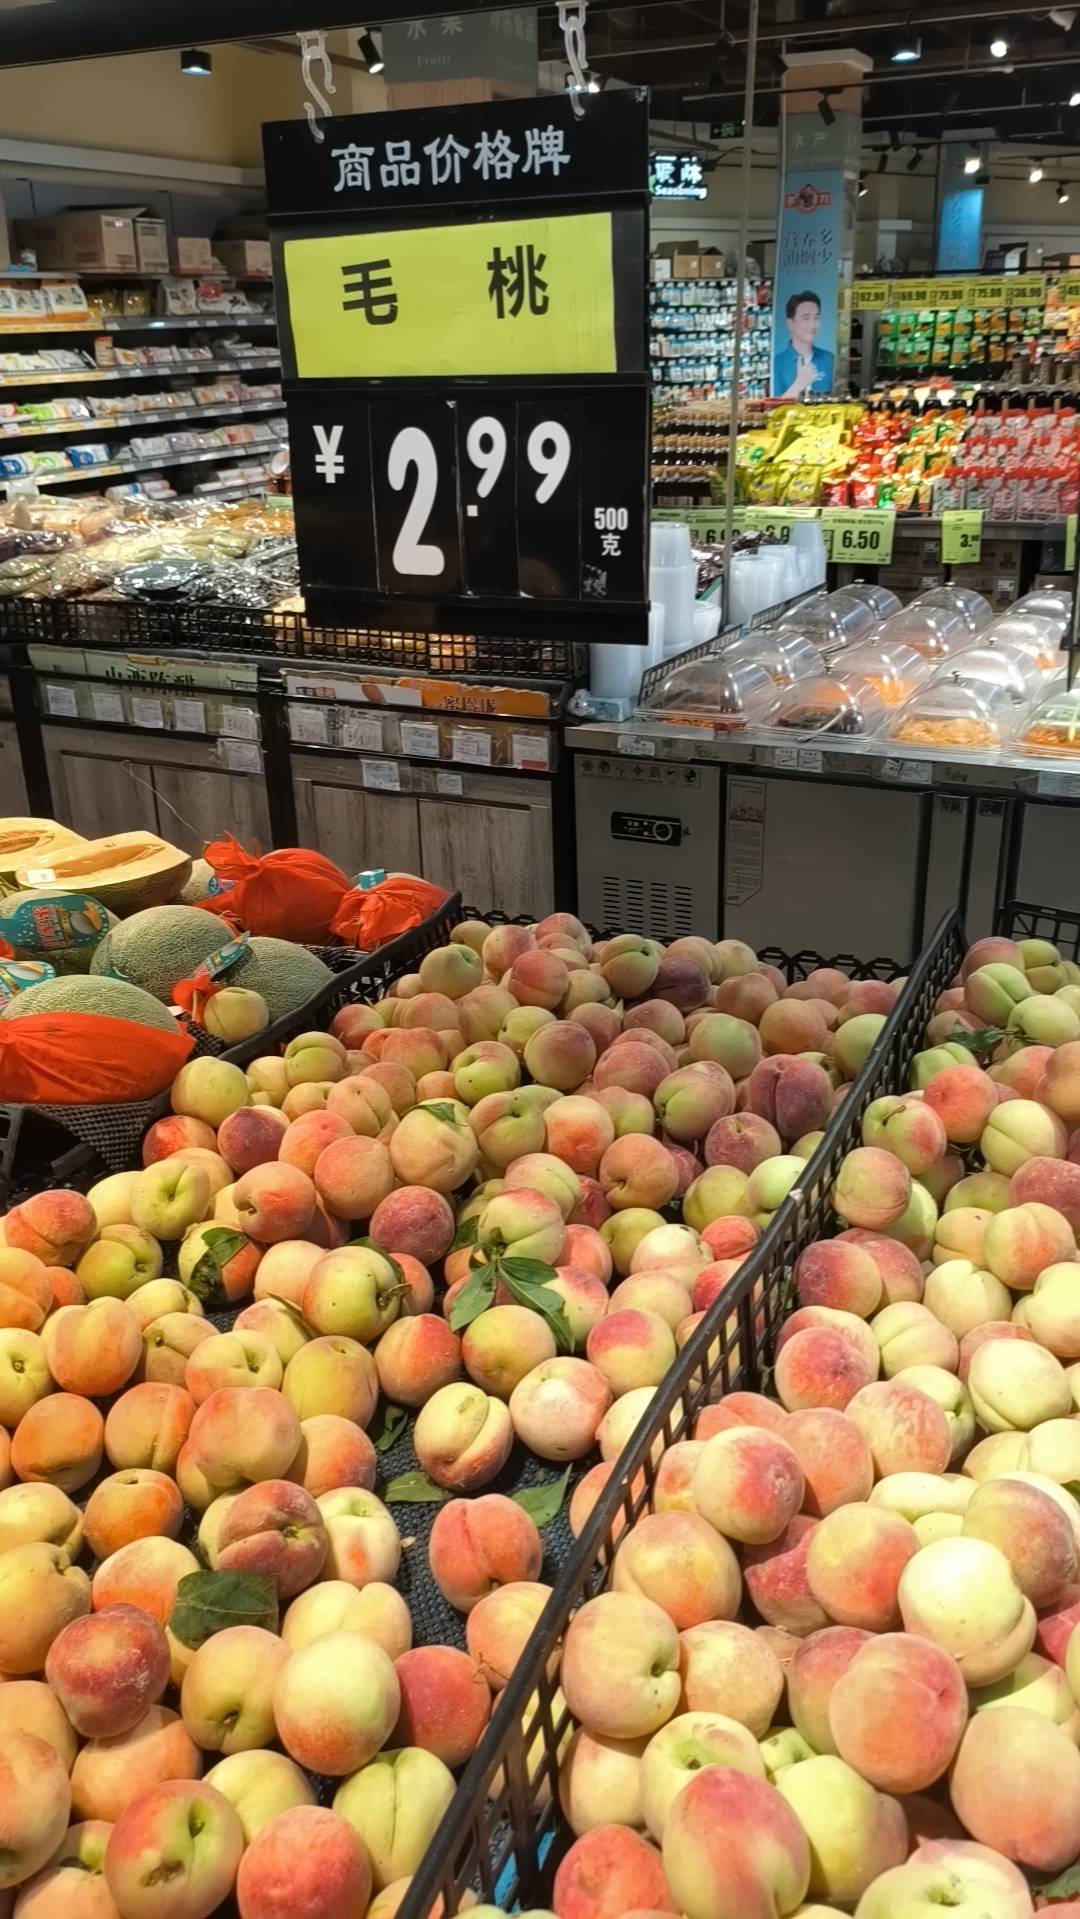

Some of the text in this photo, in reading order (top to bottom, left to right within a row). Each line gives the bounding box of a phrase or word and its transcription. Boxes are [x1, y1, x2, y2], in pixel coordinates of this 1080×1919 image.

[330, 124, 571, 193] 商品价格牌
[655, 185, 707, 199] Seasoning
[388, 416, 571, 576] 2.99
[594, 508, 628, 531] 500
[601, 534, 621, 557] 克
[842, 530, 880, 550] 6.50
